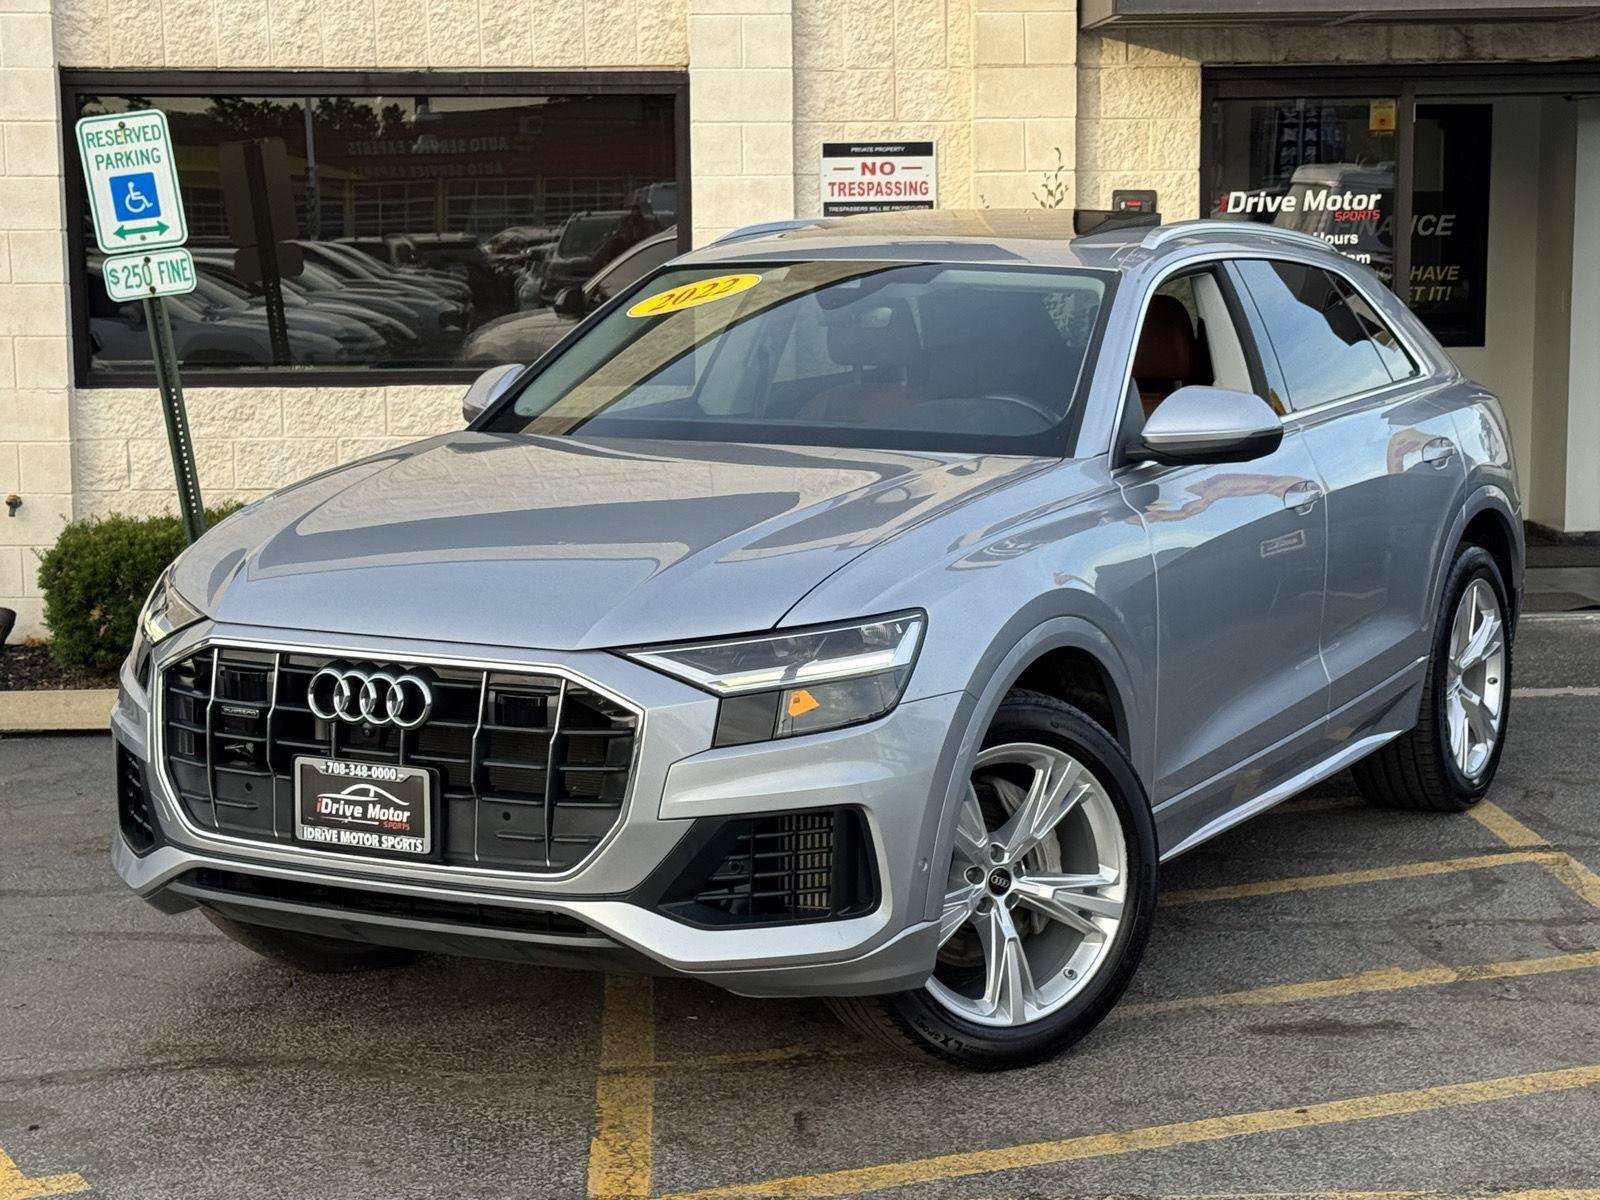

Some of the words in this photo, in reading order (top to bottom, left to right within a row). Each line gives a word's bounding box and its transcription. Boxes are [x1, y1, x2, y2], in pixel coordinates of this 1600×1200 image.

[85, 124, 162, 149] RESERVED
[95, 148, 162, 171] PARKING
[861, 161, 896, 176] NO
[828, 181, 929, 197] TRESPASSING
[828, 205, 869, 213] TRESPASSERS
[1302, 189, 1383, 212] Motor
[1334, 209, 1381, 222] SPORTS
[109, 262, 154, 290] $250
[158, 257, 192, 285] FINE
[1410, 265, 1461, 281] HAVE
[647, 277, 741, 313] 2022
[327, 761, 397, 780] 708-348-0000
[316, 798, 363, 817] iDrive
[367, 803, 411, 823] Motor
[382, 820, 411, 831] SPORTS
[339, 830, 380, 846] MOTOR
[381, 834, 424, 852] SPORTS
